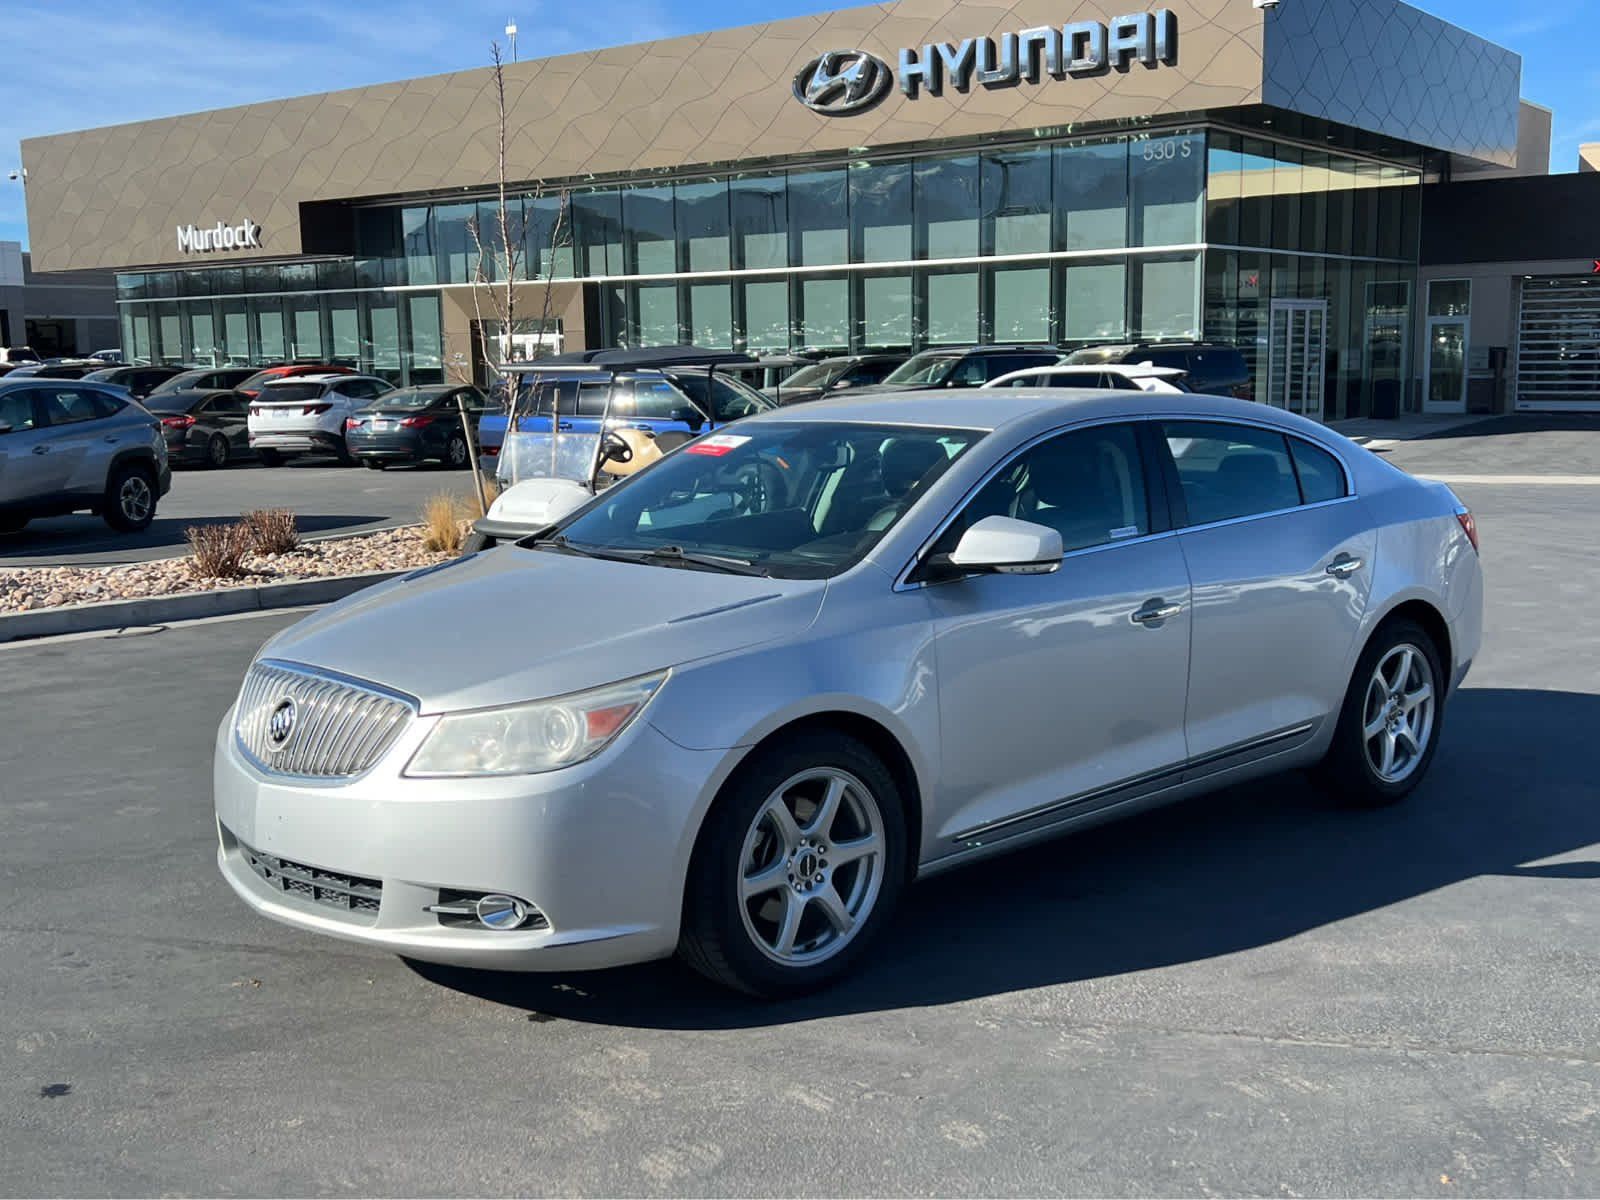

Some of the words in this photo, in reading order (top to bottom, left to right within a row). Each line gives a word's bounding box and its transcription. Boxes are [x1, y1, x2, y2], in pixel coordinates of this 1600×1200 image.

[898, 8, 1175, 97] HYUNDAI
[1143, 140, 1175, 161] 530
[1181, 139, 1192, 158] S
[176, 218, 257, 252] Murdock
